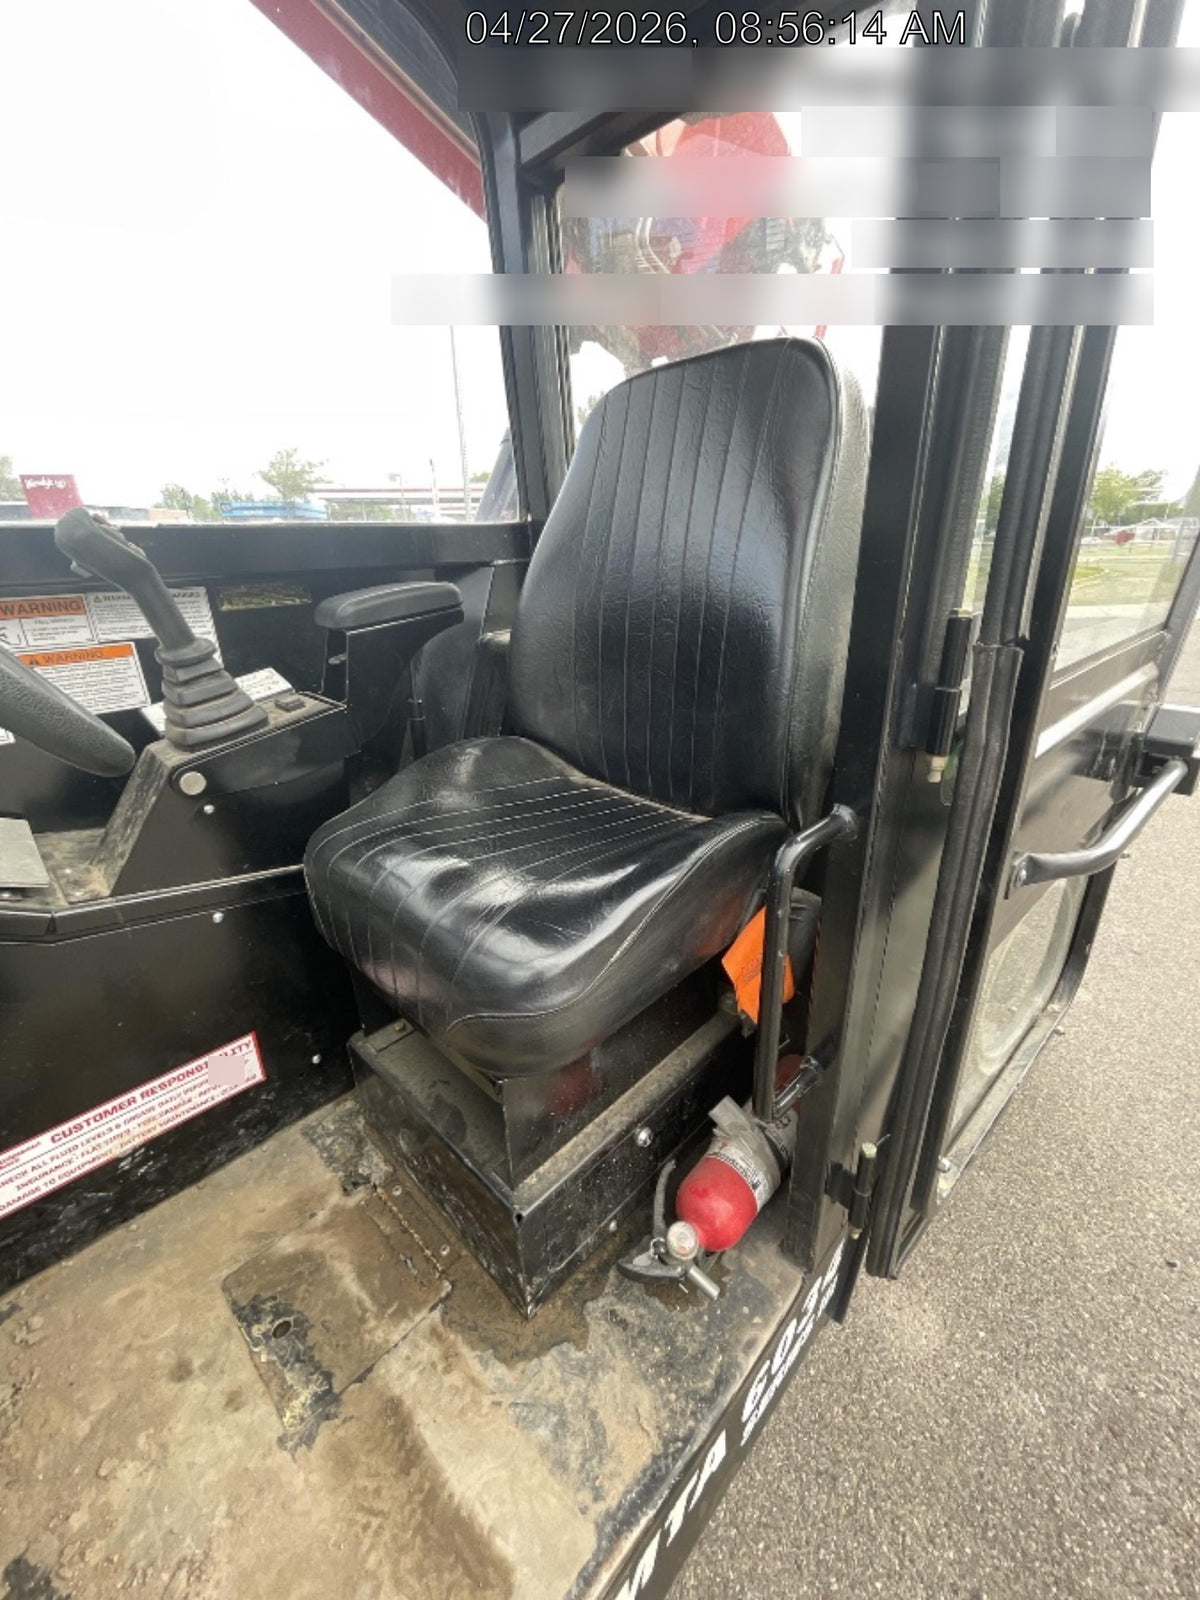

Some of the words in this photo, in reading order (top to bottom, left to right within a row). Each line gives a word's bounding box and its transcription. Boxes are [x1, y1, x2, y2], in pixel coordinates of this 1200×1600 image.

[0, 599, 84, 615] WARNING
[42, 650, 105, 665] WARNING
[50, 1096, 137, 1144] CUSTOMER
